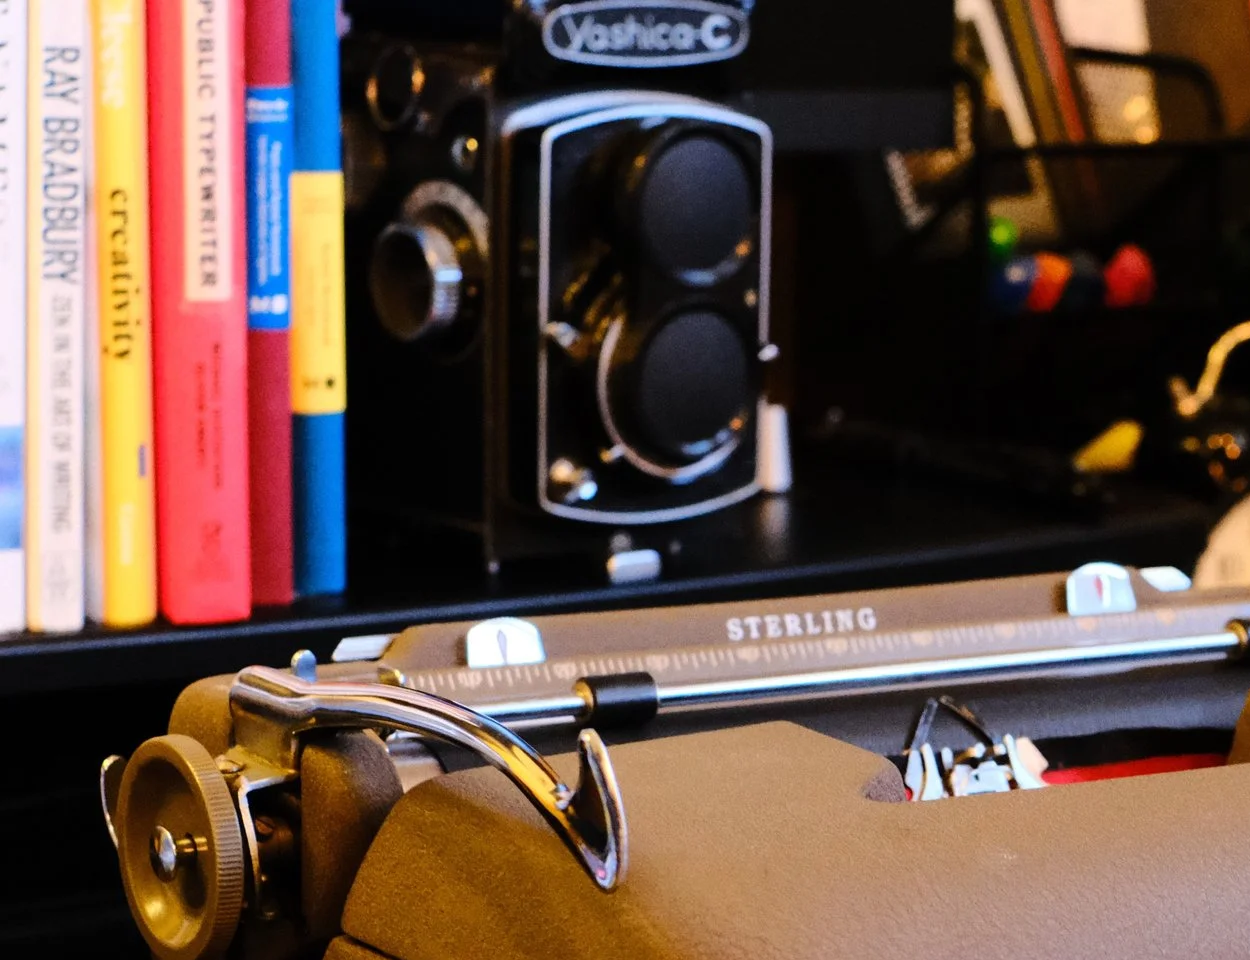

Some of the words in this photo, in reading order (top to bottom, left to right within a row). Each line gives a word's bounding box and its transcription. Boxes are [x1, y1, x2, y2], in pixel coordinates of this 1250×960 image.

[41, 45, 81, 106] RAY
[560, 13, 733, 51] Yashica-C
[41, 117, 81, 286] BRADBURY
[198, 112, 219, 289] TYPEWRITER
[103, 188, 142, 361] creativity
[726, 606, 878, 642] STERLING
